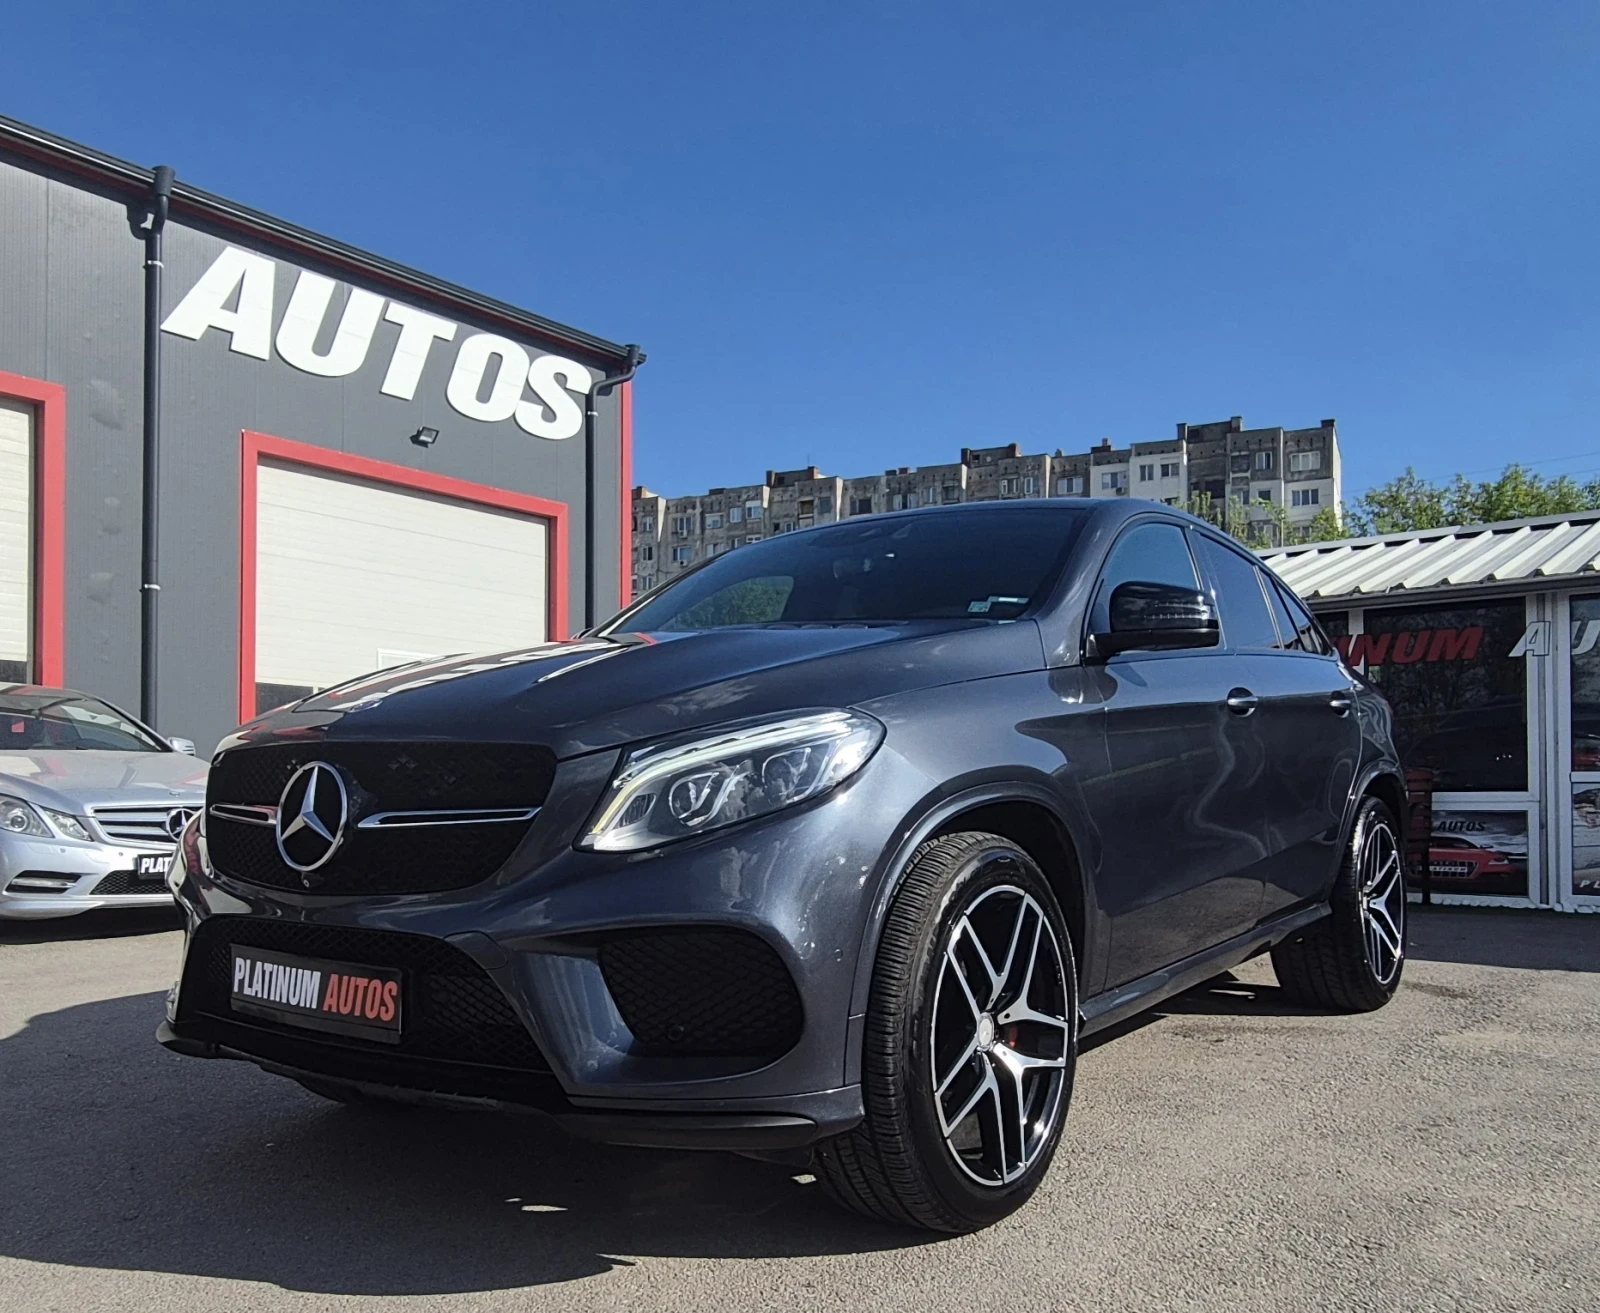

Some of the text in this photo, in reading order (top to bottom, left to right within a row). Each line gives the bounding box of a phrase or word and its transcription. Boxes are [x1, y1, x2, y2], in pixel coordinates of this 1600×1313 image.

[160, 246, 593, 440] AUTOS
[1331, 626, 1485, 666] INUM
[1437, 820, 1486, 832] AUTOS
[233, 957, 398, 1021] PLATINUM AUTOS
